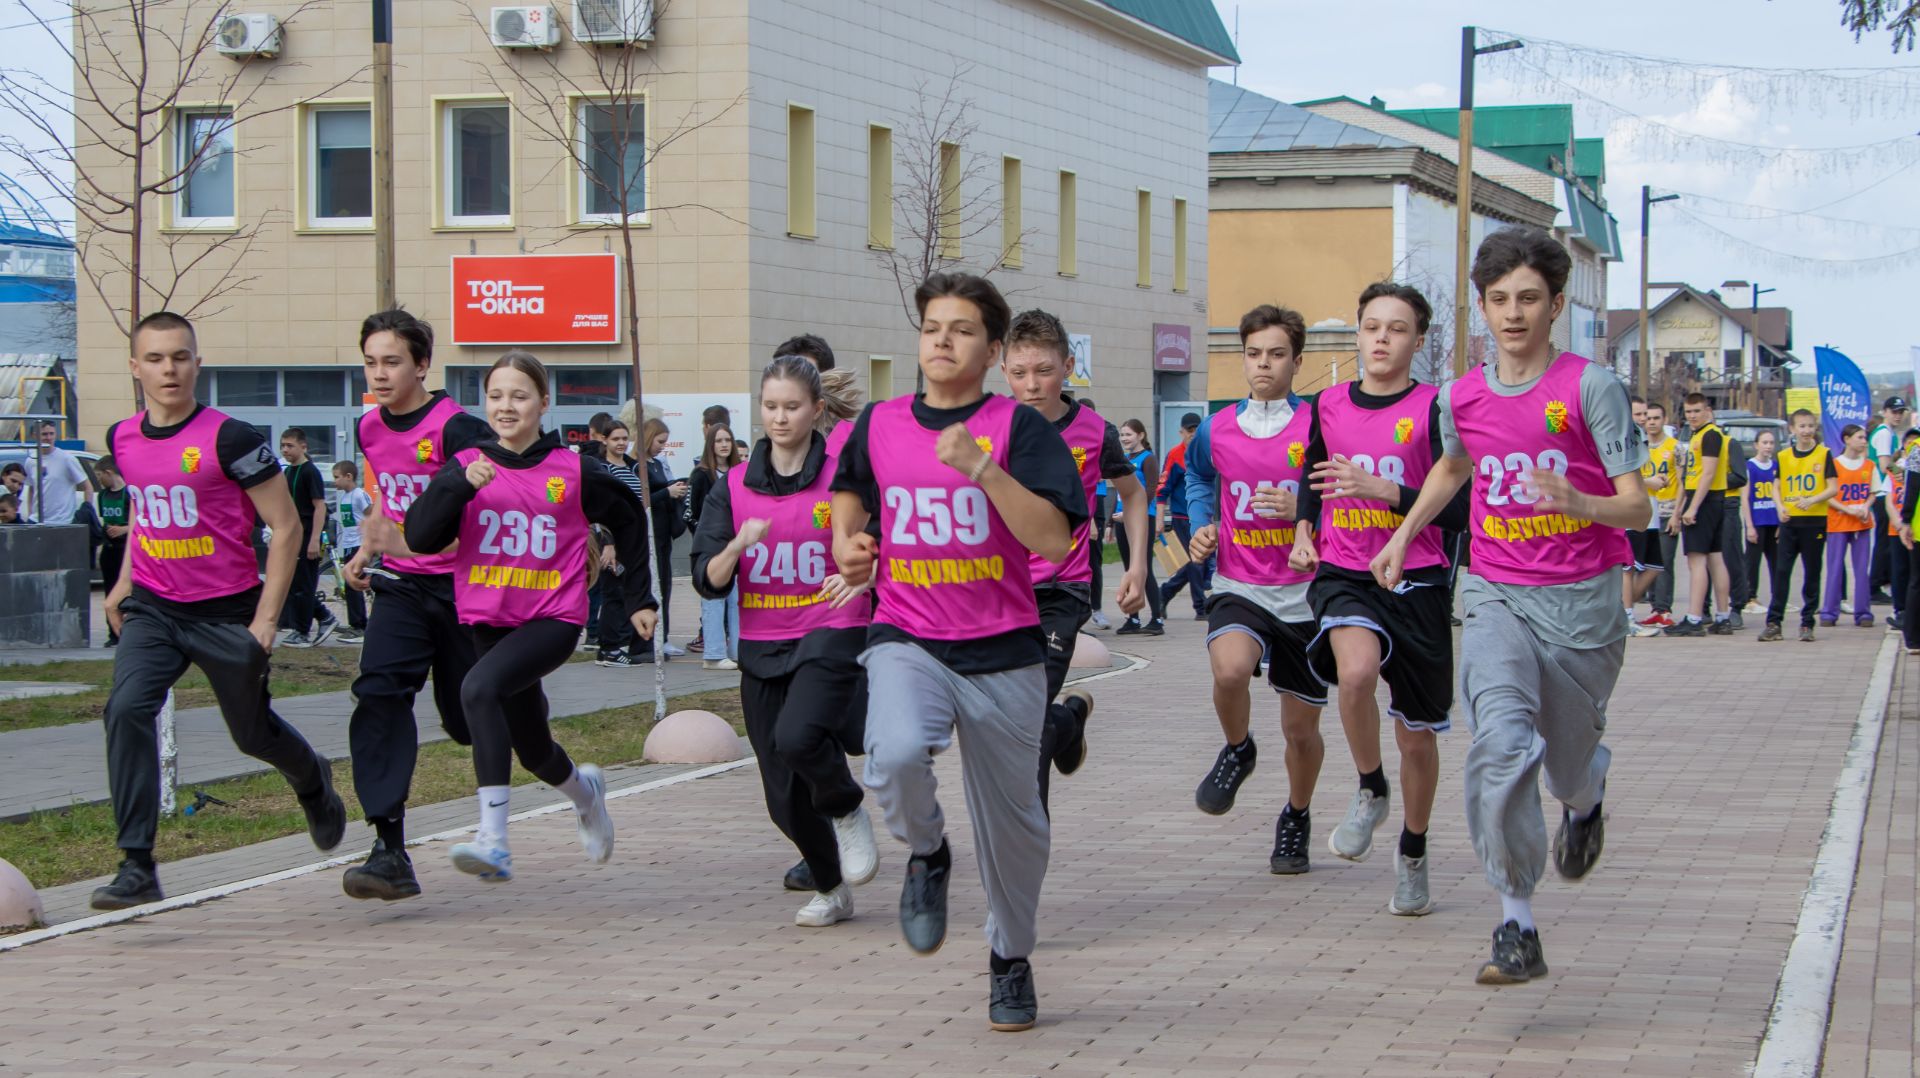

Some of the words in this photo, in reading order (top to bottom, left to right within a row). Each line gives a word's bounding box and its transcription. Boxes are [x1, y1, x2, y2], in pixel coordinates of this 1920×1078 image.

[1786, 474, 1816, 492] 110
[1840, 484, 1870, 501] 285
[127, 484, 199, 528] 260
[885, 486, 990, 546] 259
[478, 509, 557, 560] 236
[468, 565, 562, 590] АБДУЛИНО
[745, 541, 826, 584] 246
[889, 554, 1005, 589] АБДУЛИНО
